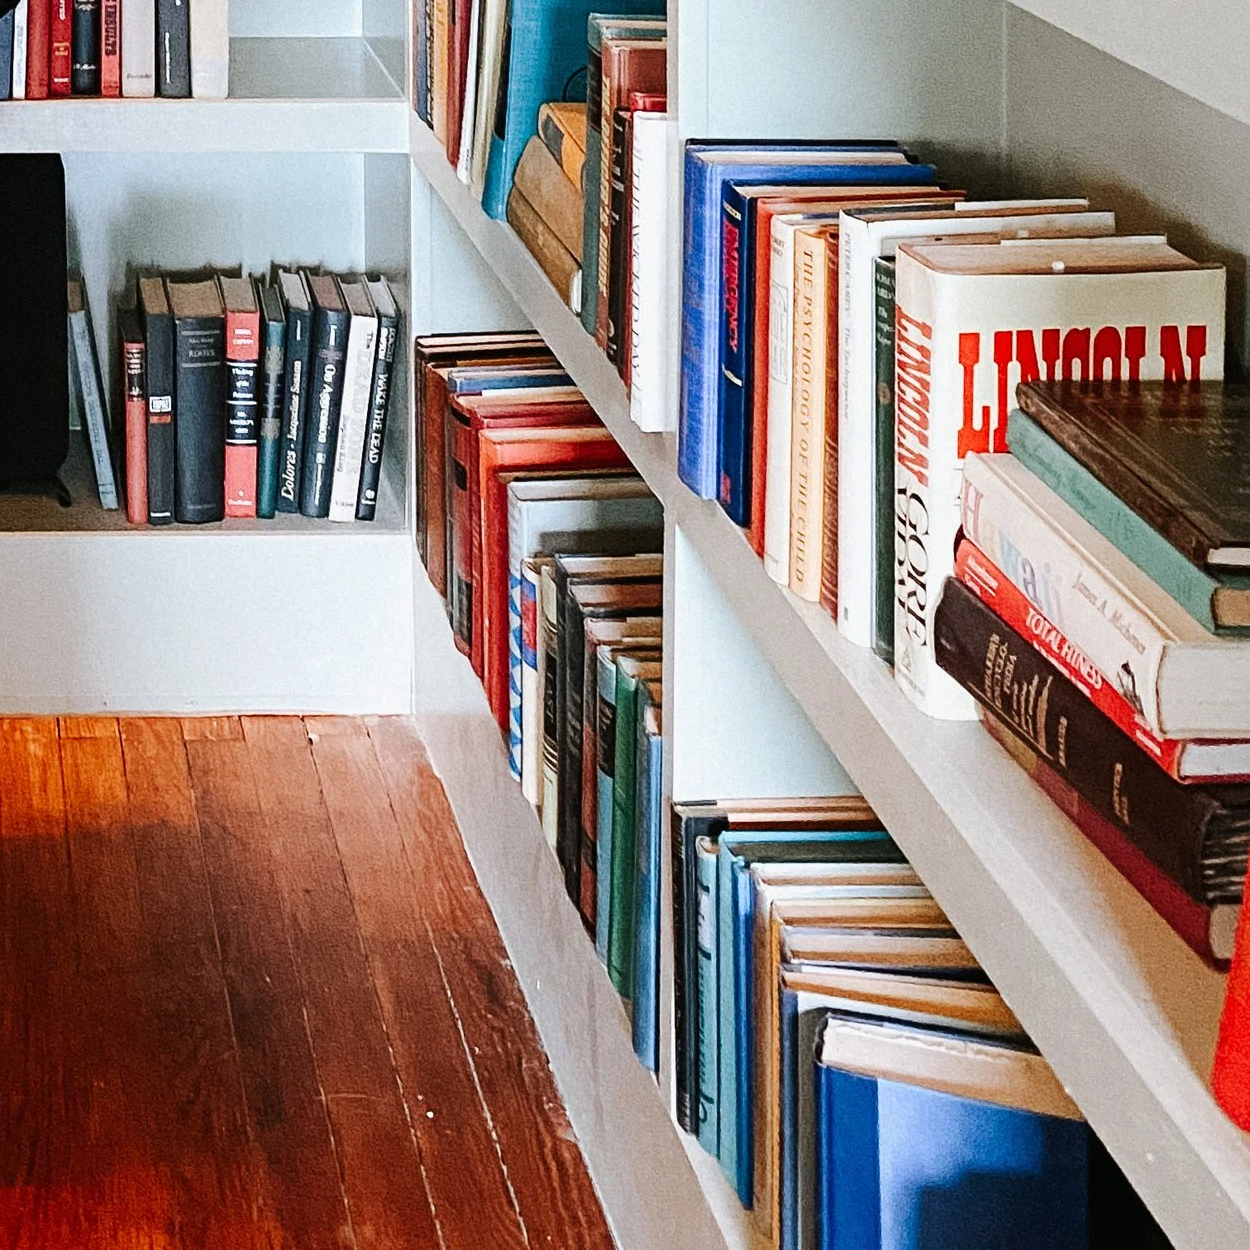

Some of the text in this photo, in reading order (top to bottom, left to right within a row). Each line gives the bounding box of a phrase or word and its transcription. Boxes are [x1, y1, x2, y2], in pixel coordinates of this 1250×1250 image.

[105, 5, 117, 56] INSULTS
[632, 224, 640, 323] WICKED
[188, 350, 215, 358] ROOTS
[366, 331, 374, 349] The
[280, 360, 302, 500] Dolores Jacqueline Susann
[317, 363, 335, 444] On Aggression
[369, 373, 389, 464] WAKE THE DEAD
[795, 250, 814, 583] THE PSYCHOLOGY OF THE CHILD
[895, 305, 932, 647] LINCOLN GORE
[1024, 607, 1064, 651] TOTAL
